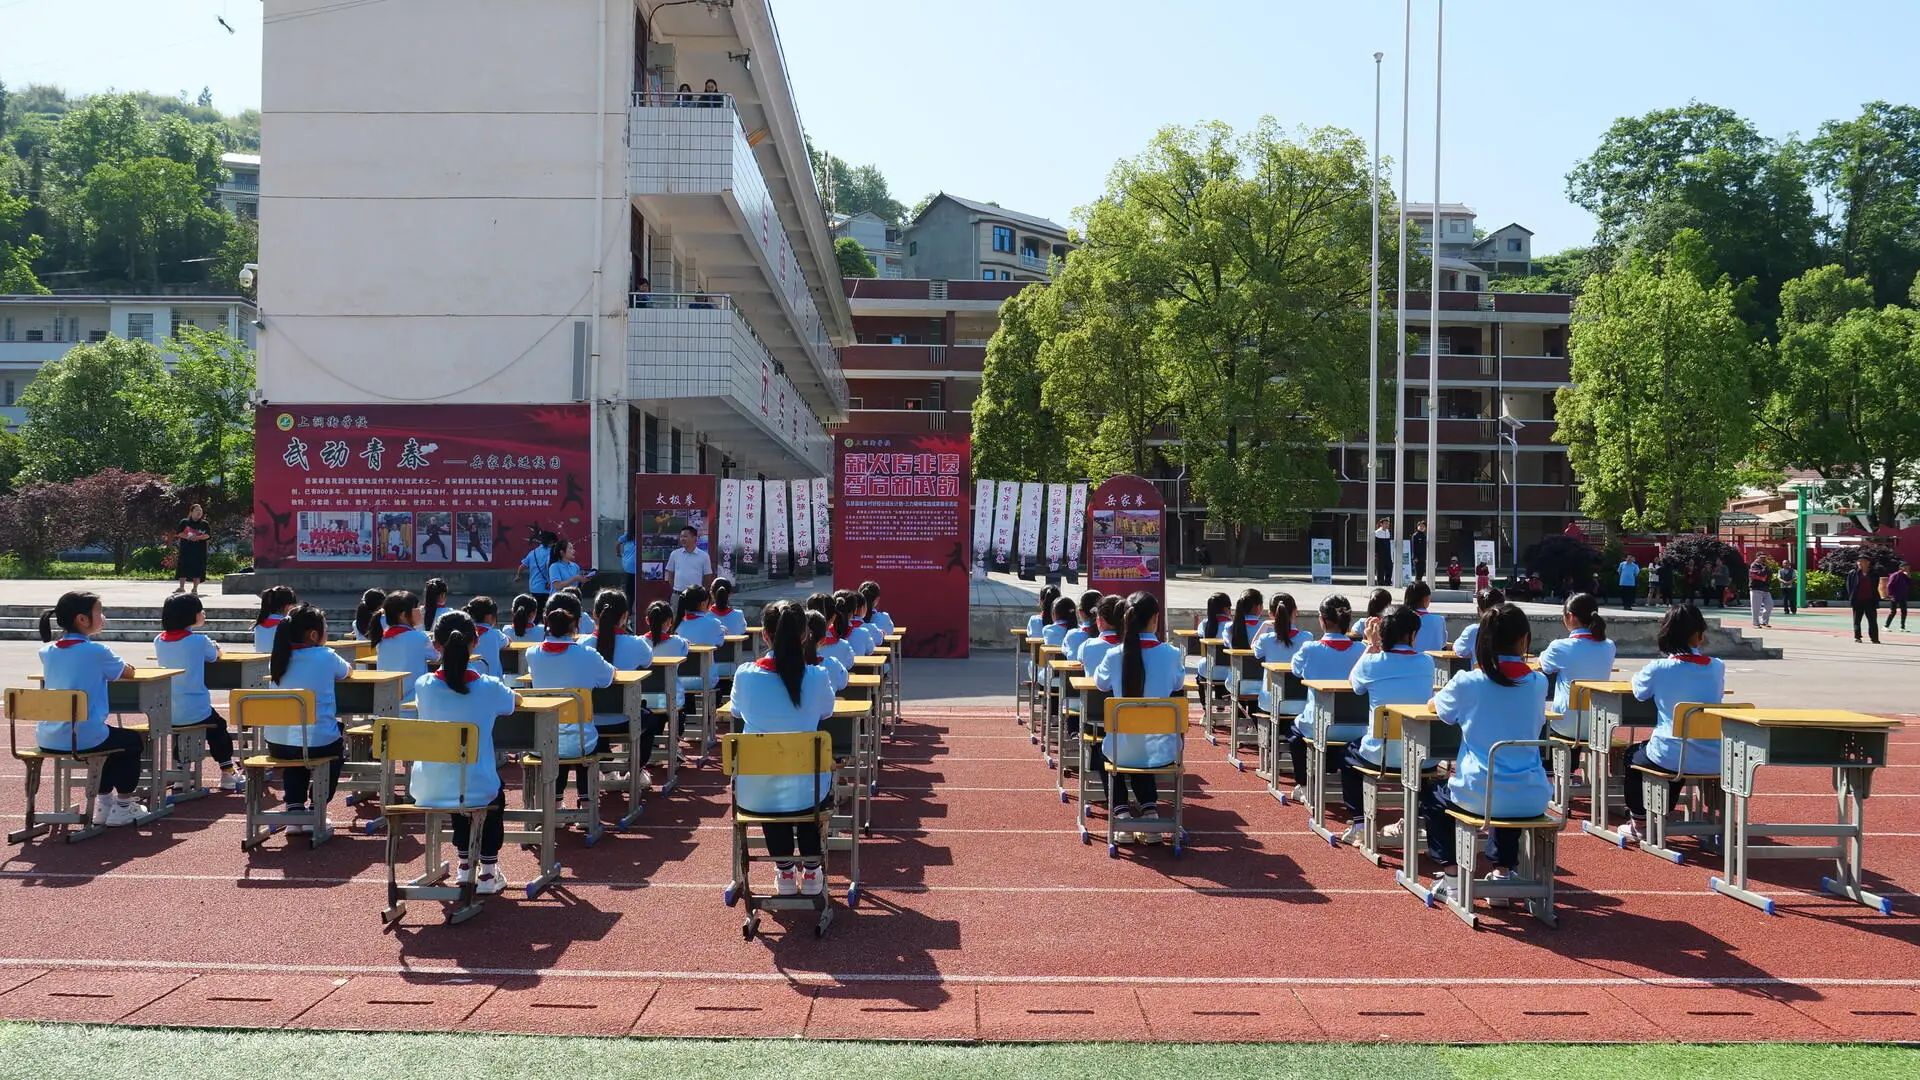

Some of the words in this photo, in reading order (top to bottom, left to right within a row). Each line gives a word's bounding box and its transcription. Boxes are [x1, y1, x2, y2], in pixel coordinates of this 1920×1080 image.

[283, 437, 431, 471] 武动青春
[845, 453, 960, 475] 薪火传非遗
[844, 475, 960, 497] 智启新武韵
[655, 492, 697, 507] 太极拳
[1104, 494, 1147, 507] 岳家拳
